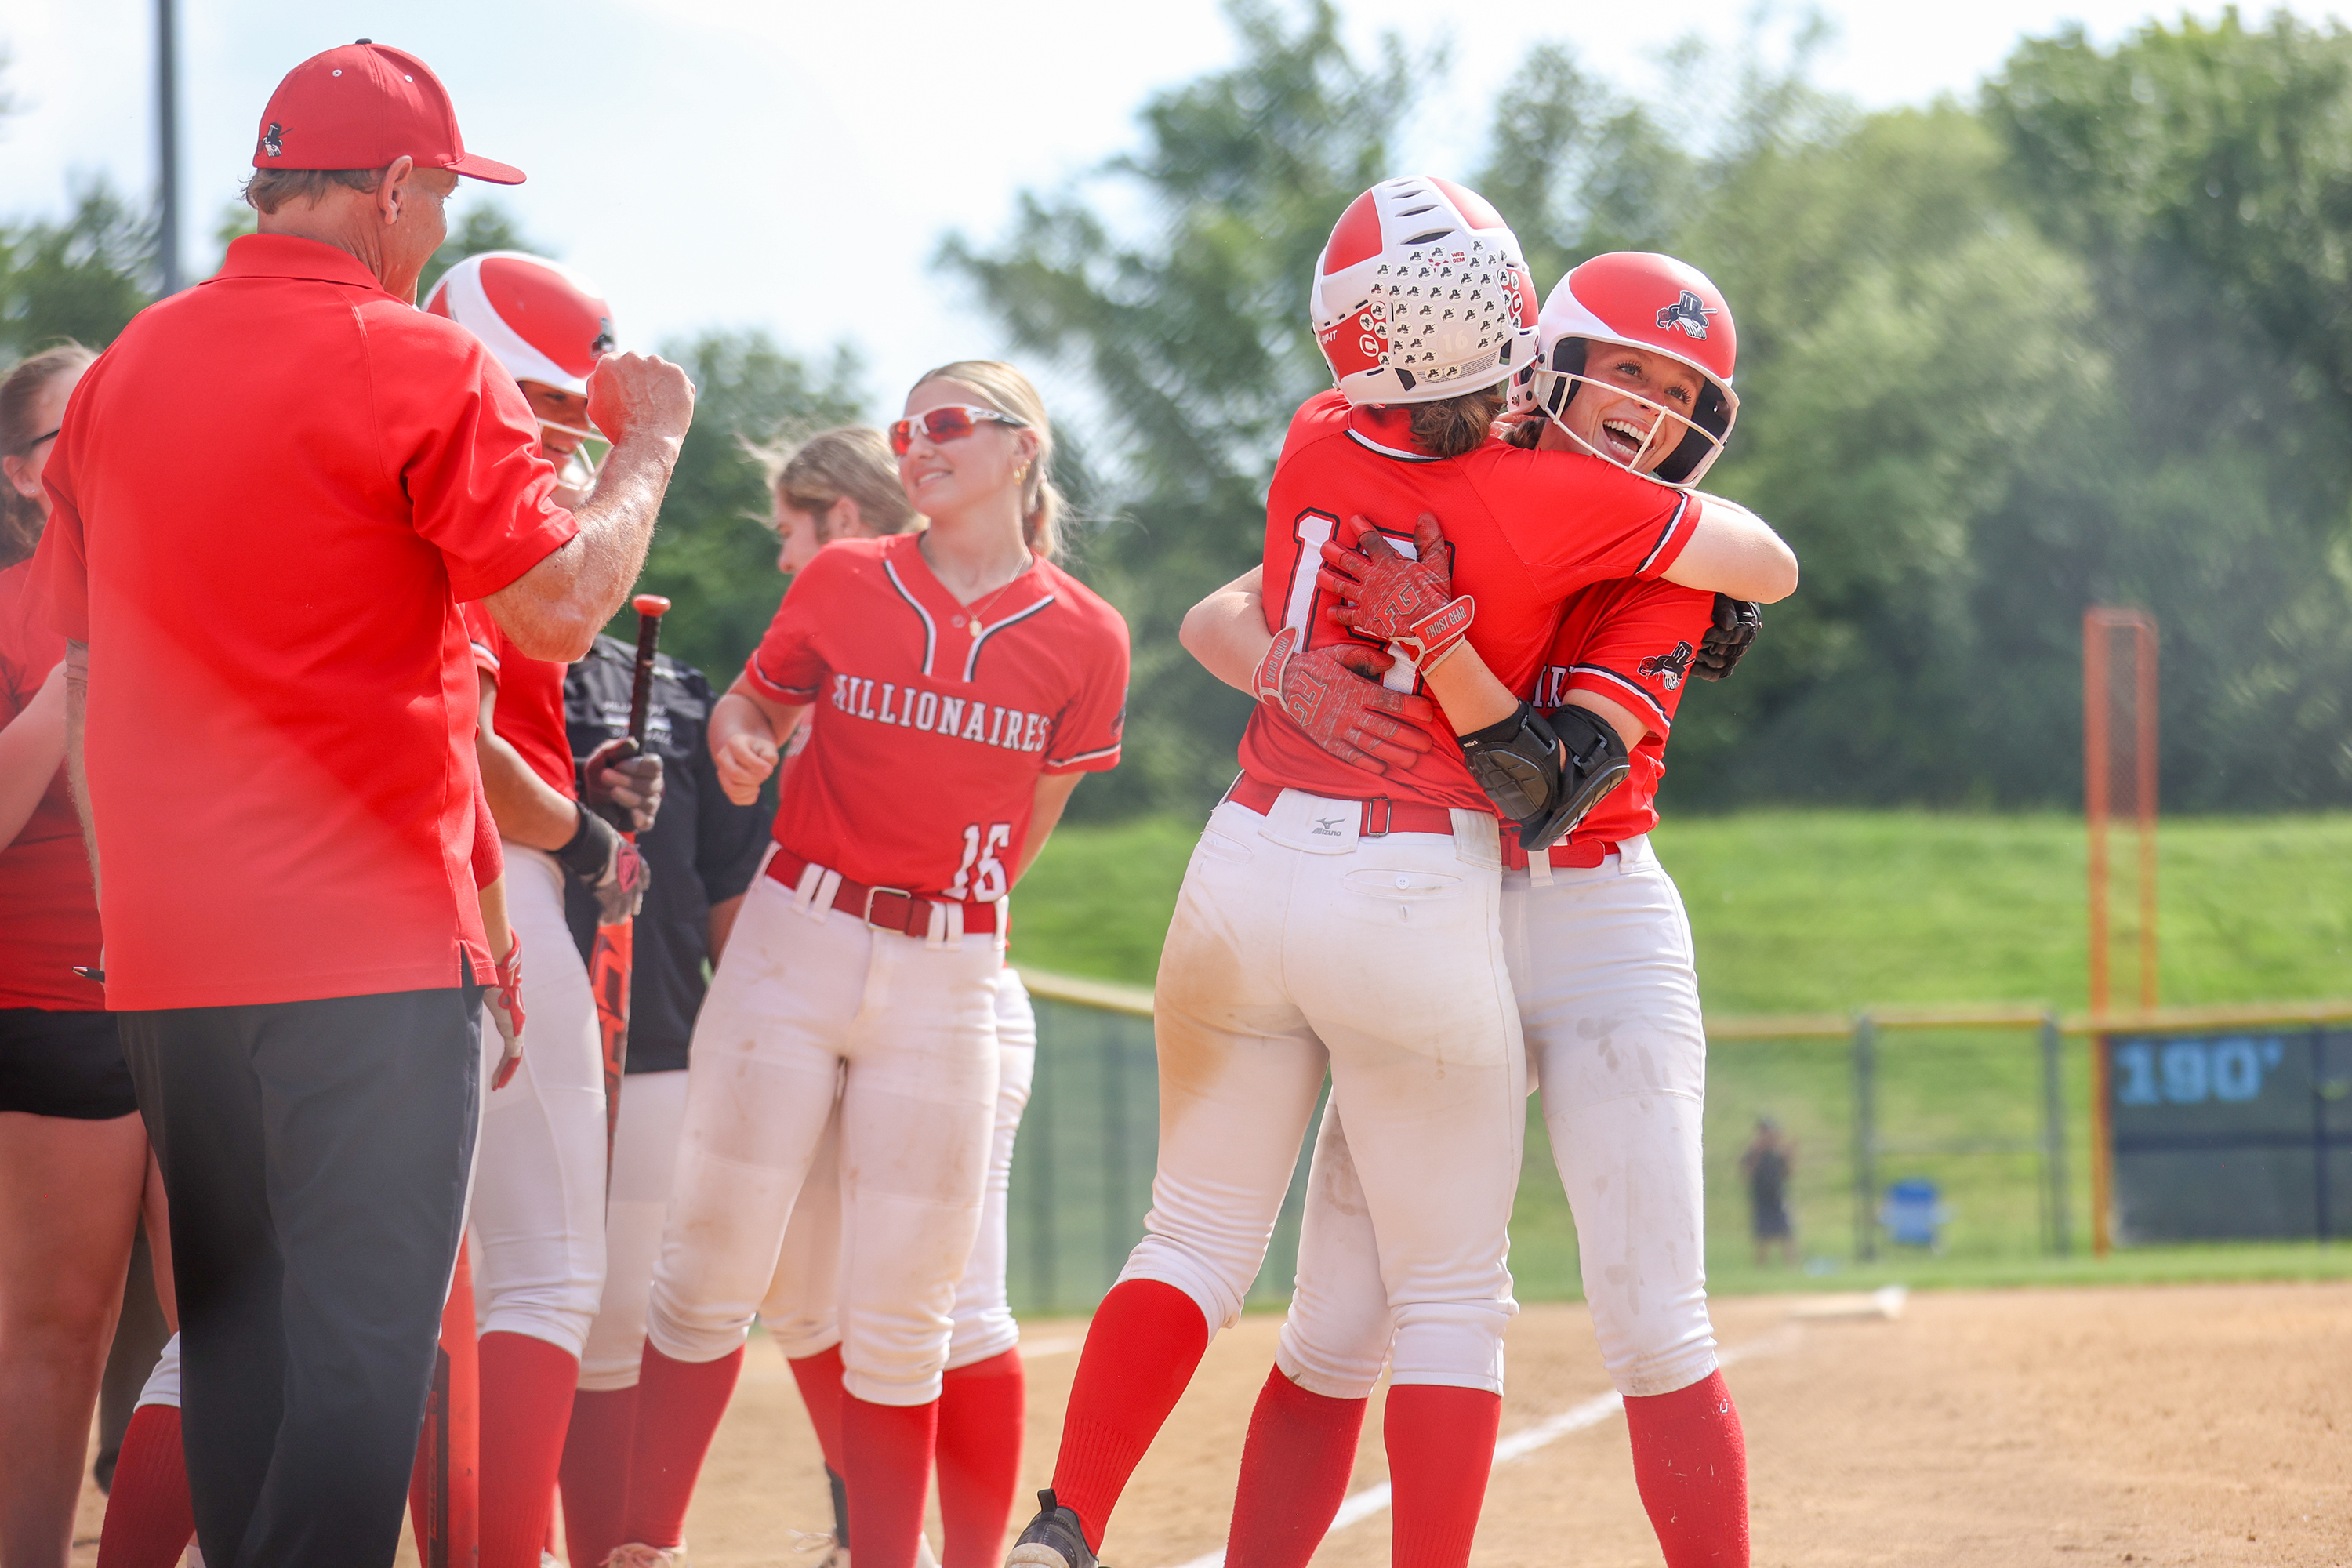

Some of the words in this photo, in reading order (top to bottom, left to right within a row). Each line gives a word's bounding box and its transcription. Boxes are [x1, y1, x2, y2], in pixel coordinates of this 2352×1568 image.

[1512, 293, 1522, 312] C
[1362, 336, 1377, 354] C
[1442, 329, 1468, 353] 16
[1373, 583, 1421, 636] FG
[1425, 615, 1450, 640] FROST
[1448, 605, 1467, 626] GEAR
[1272, 636, 1290, 661] FROST
[1265, 660, 1279, 684] GEAR
[1287, 670, 1328, 726] FG
[940, 822, 1011, 903] 16
